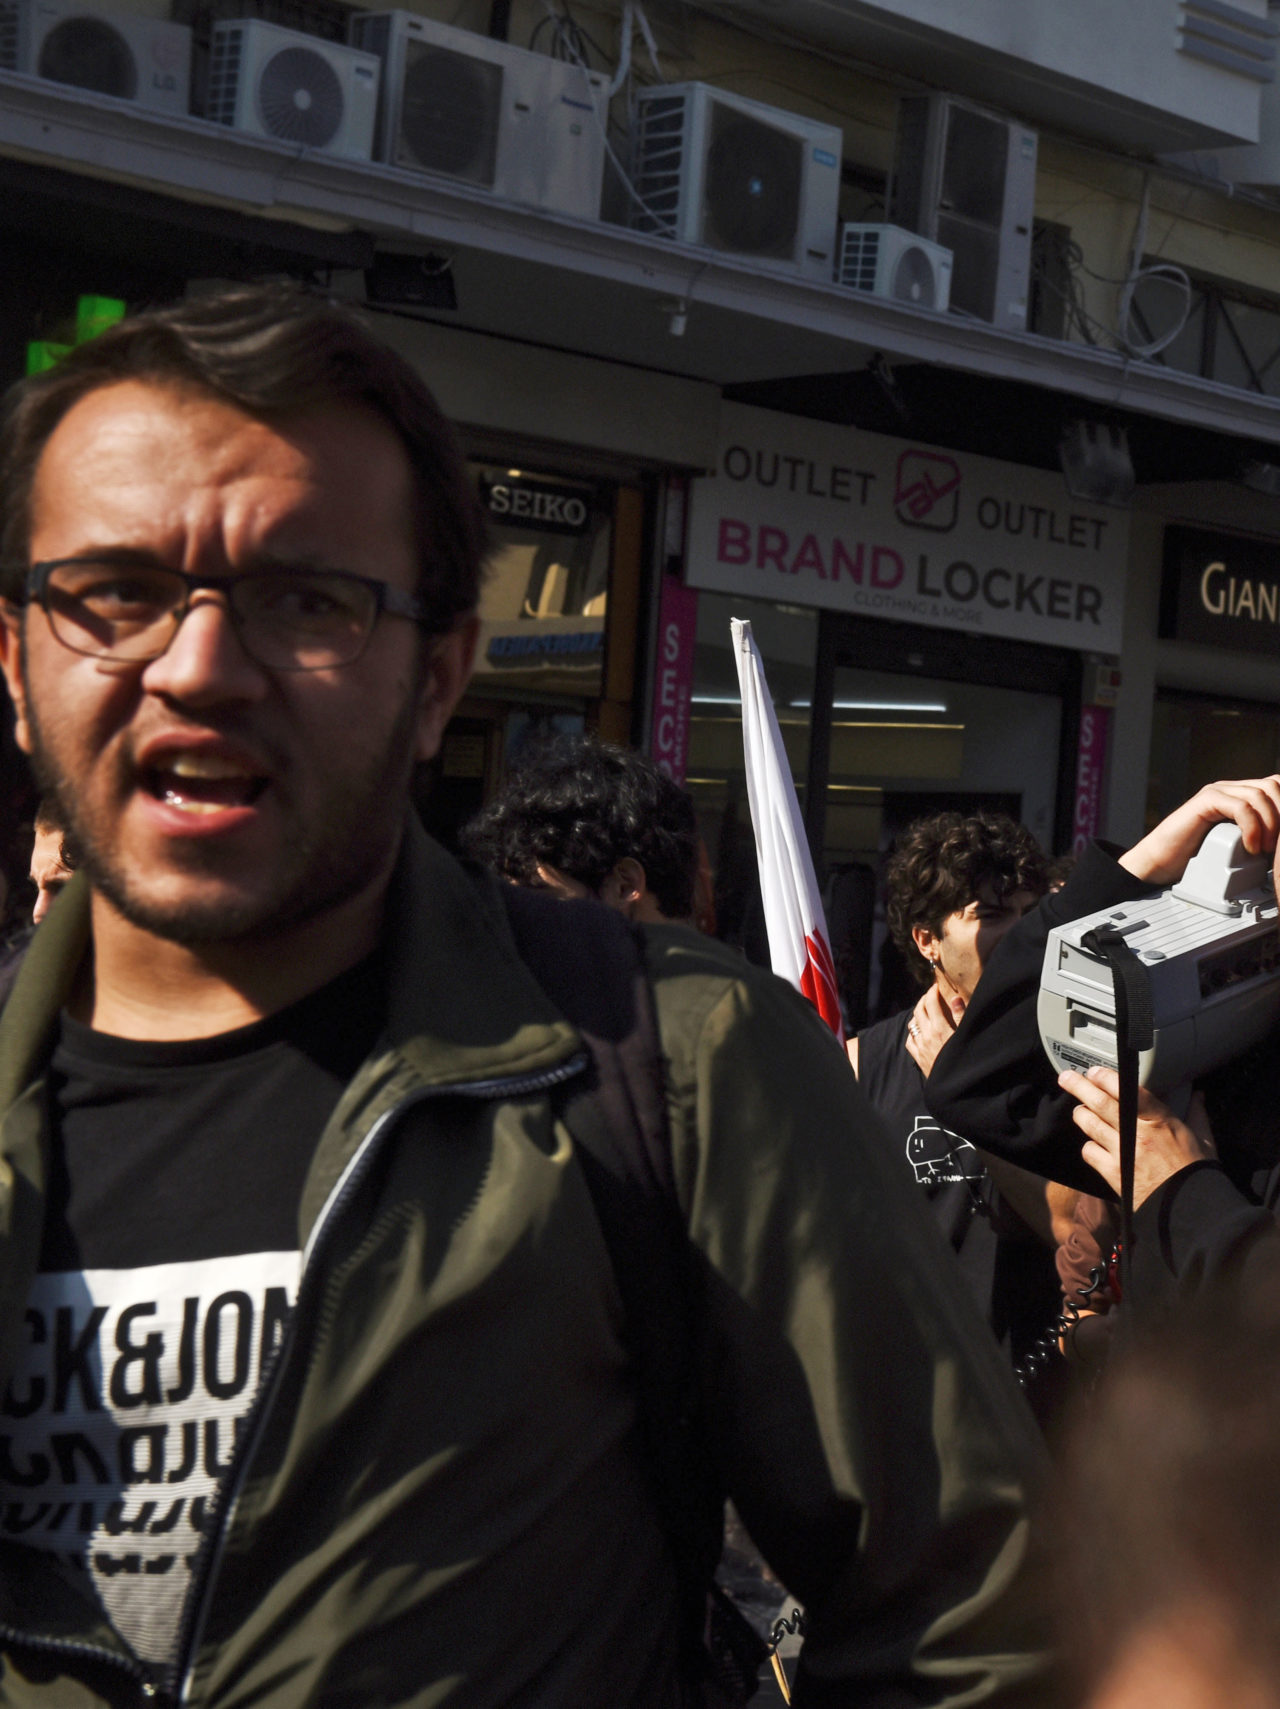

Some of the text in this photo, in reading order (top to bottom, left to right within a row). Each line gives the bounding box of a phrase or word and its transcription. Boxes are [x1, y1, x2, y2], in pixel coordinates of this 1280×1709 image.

[724, 445, 877, 506] OUTLET
[489, 484, 587, 527] SEIKO
[977, 496, 1109, 550] OUTLET
[716, 517, 1103, 626] BRAND LOCKER
[853, 590, 929, 616] CLOTHING
[942, 605, 985, 625] MORE
